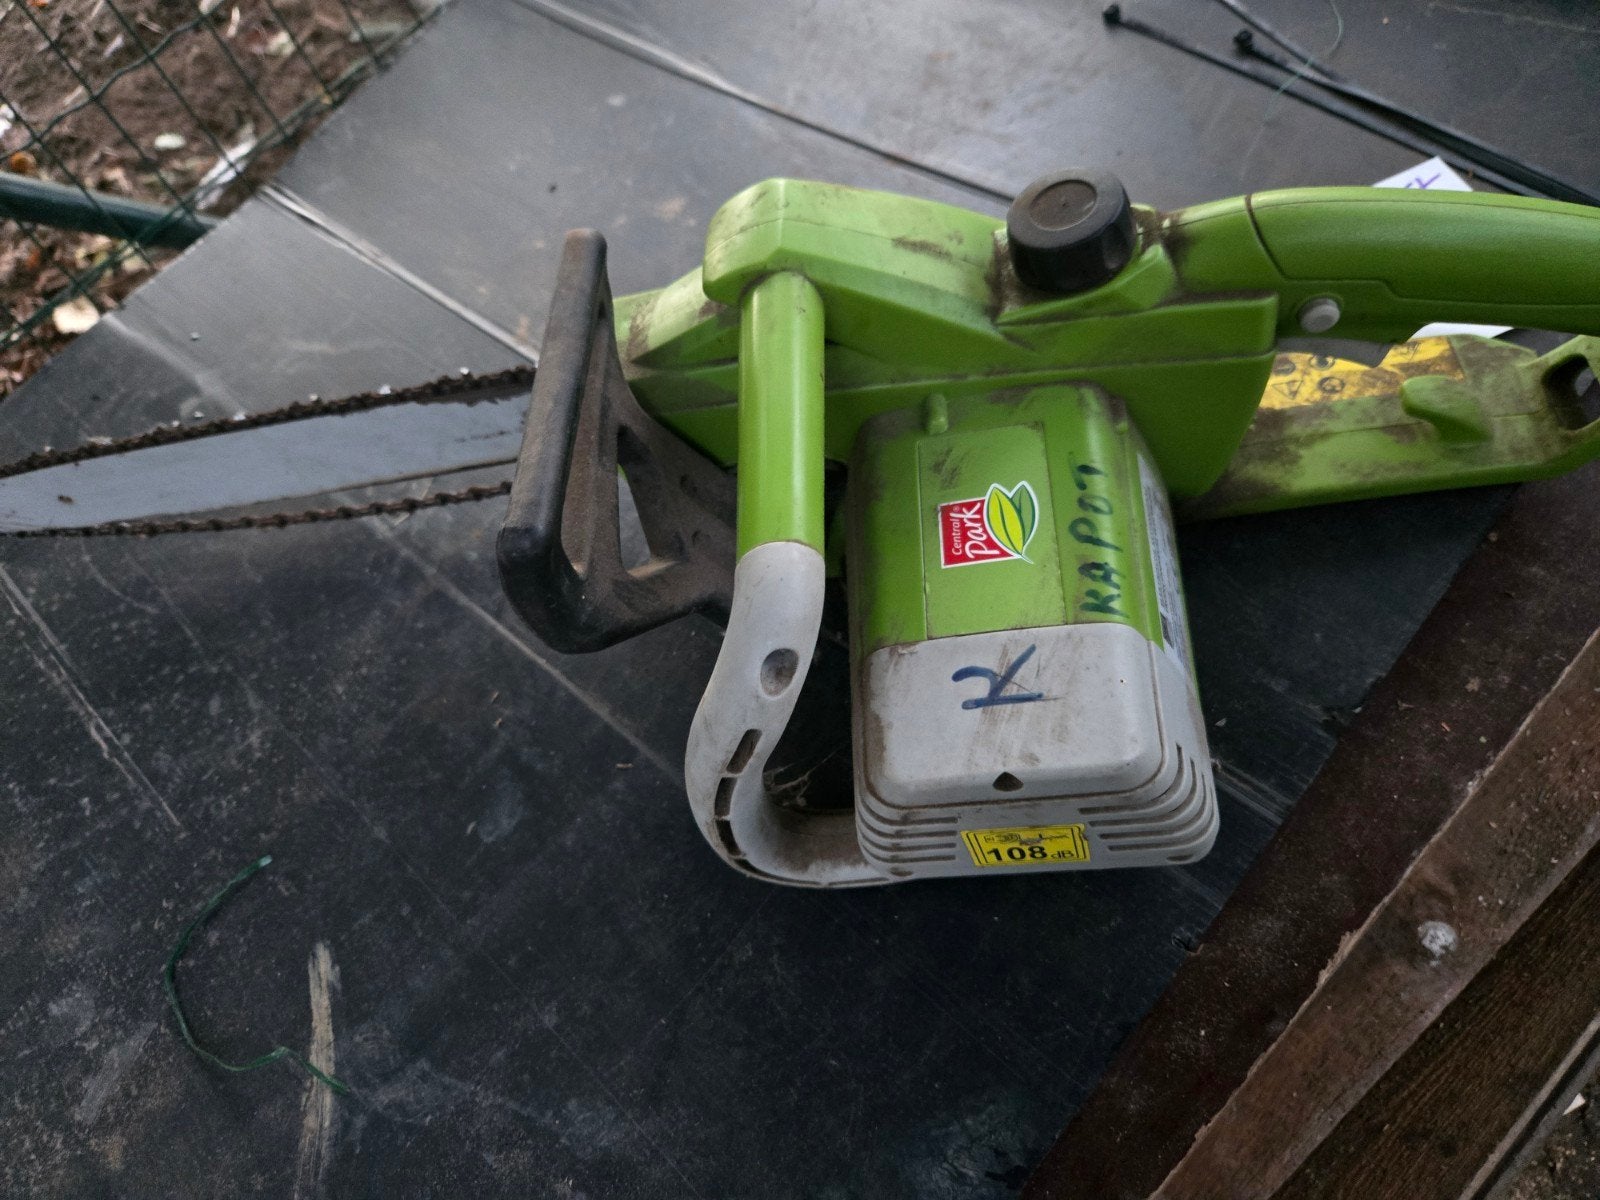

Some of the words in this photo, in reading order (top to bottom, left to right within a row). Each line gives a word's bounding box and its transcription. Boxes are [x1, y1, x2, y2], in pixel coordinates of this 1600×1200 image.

[950, 503, 1000, 558] Park
[950, 520, 961, 555] Central
[987, 845, 1048, 861] 108
[1050, 849, 1075, 860] dB
